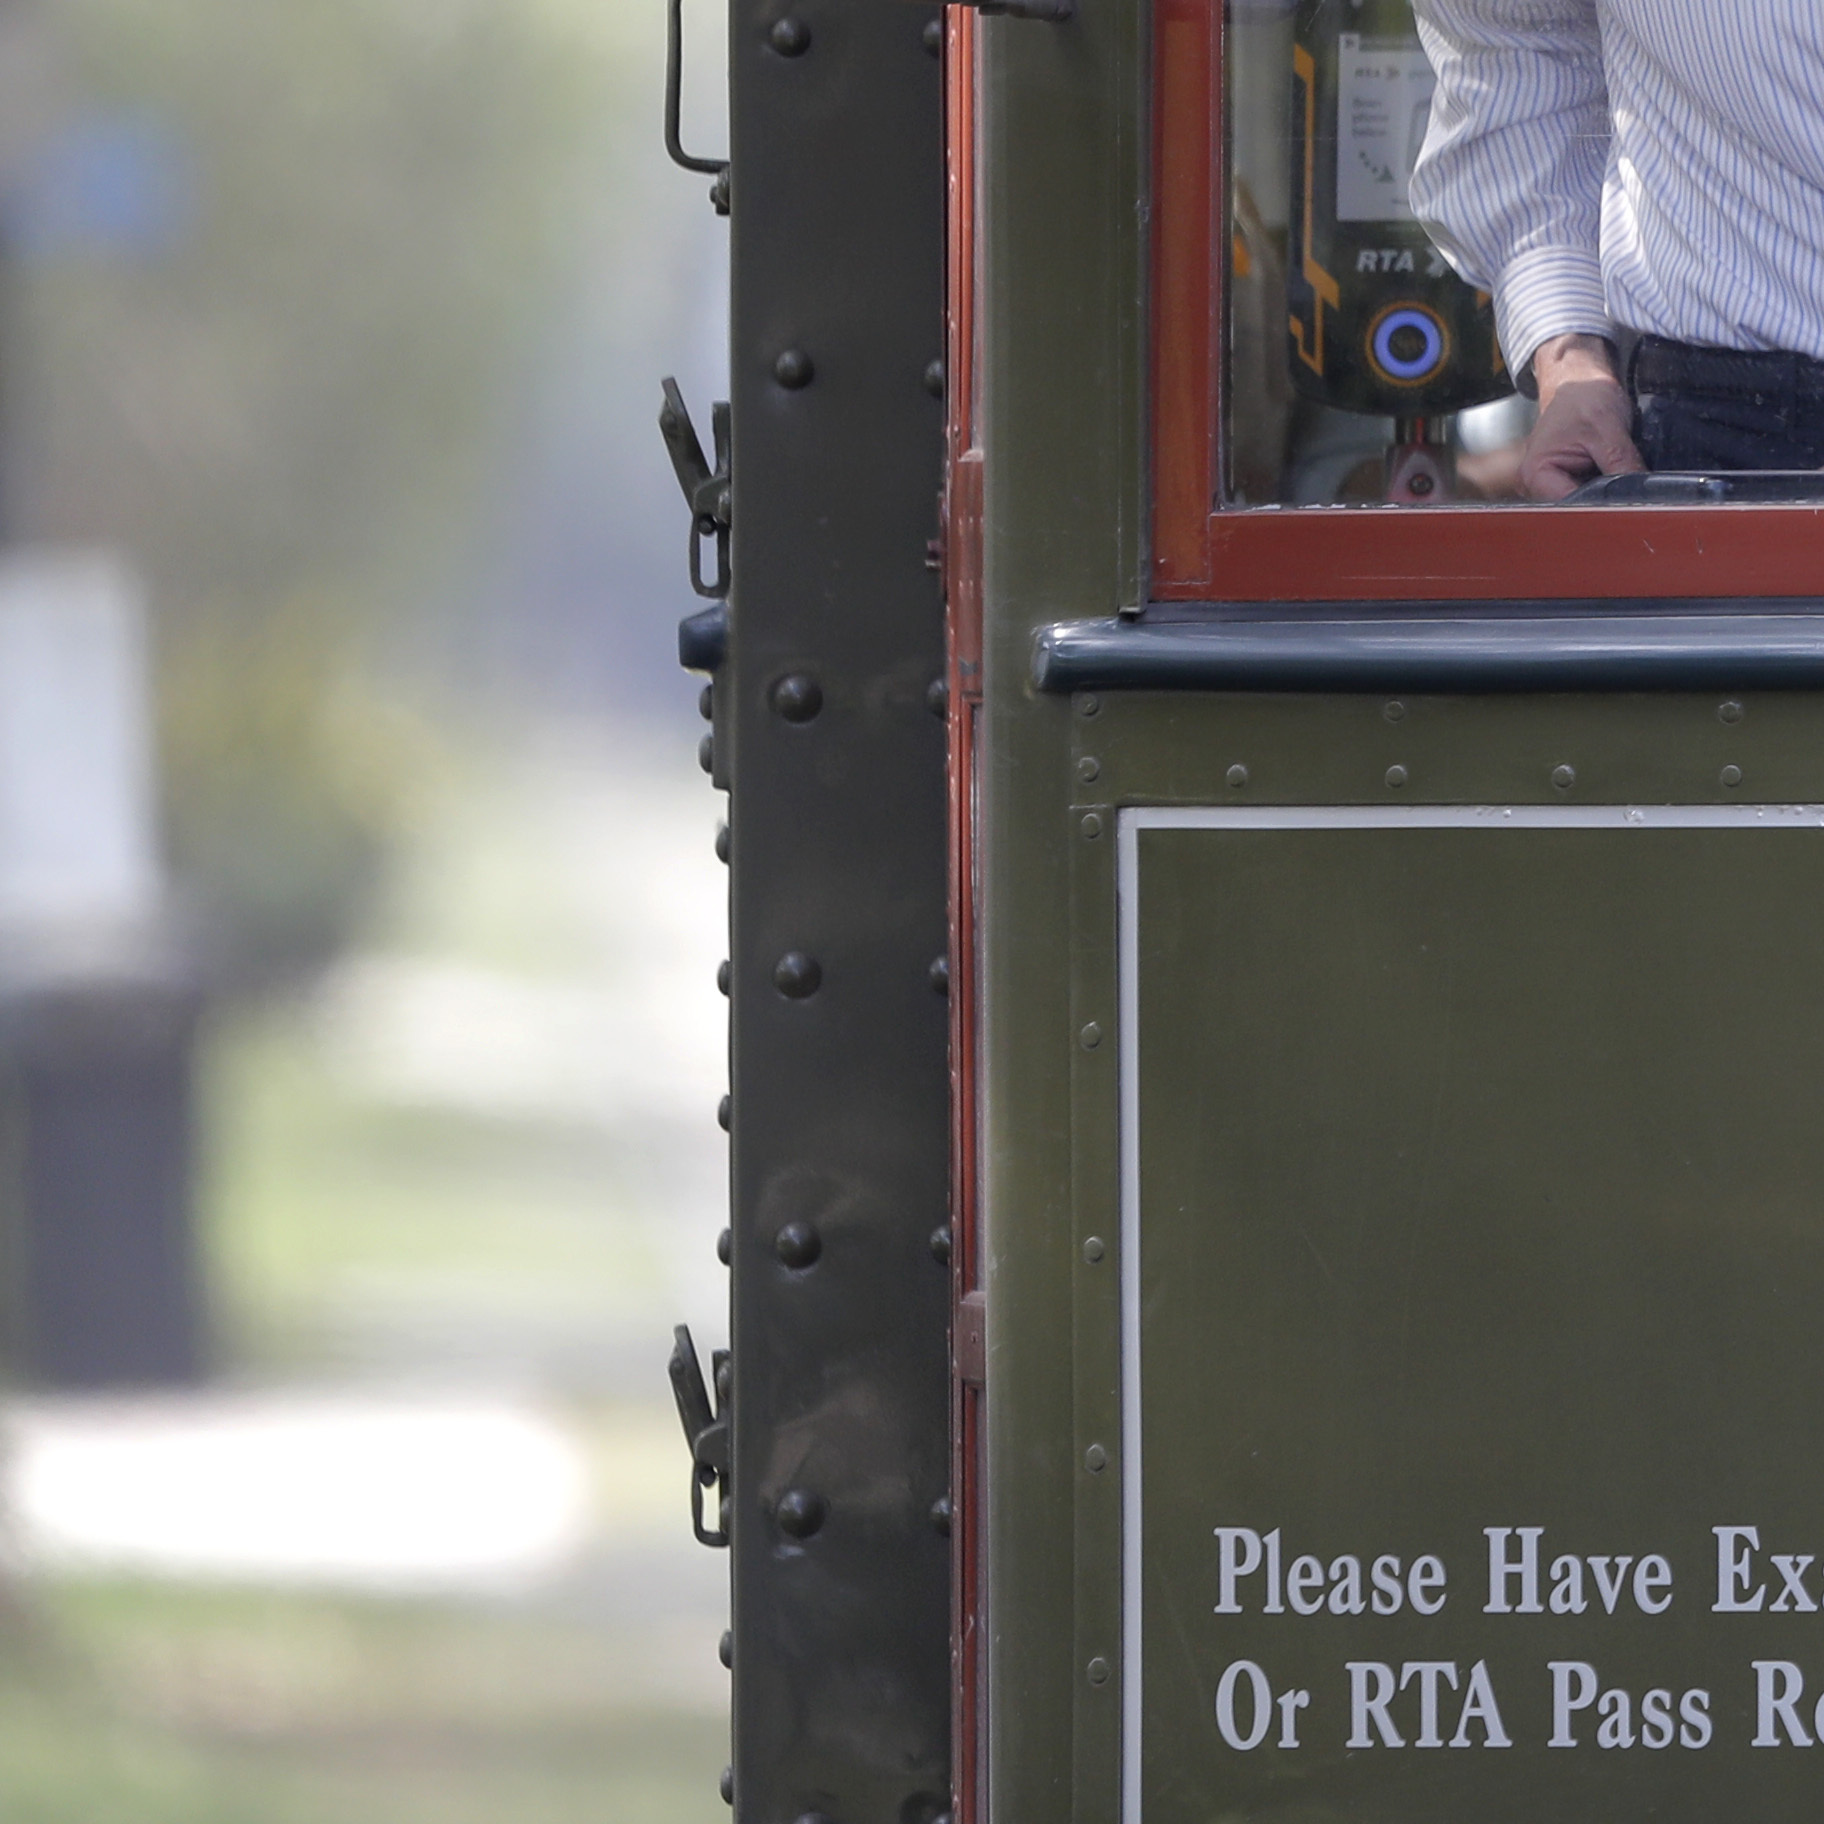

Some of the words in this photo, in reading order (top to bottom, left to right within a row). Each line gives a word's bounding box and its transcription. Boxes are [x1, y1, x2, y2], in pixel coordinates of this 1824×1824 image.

[1356, 249, 1414, 273] RTA
[1213, 1526, 1446, 1616] Please
[1482, 1526, 1673, 1616] Have
[1215, 1659, 1310, 1752] Or
[1344, 1659, 1513, 1749] RTA
[1547, 1661, 1714, 1750] Pass
